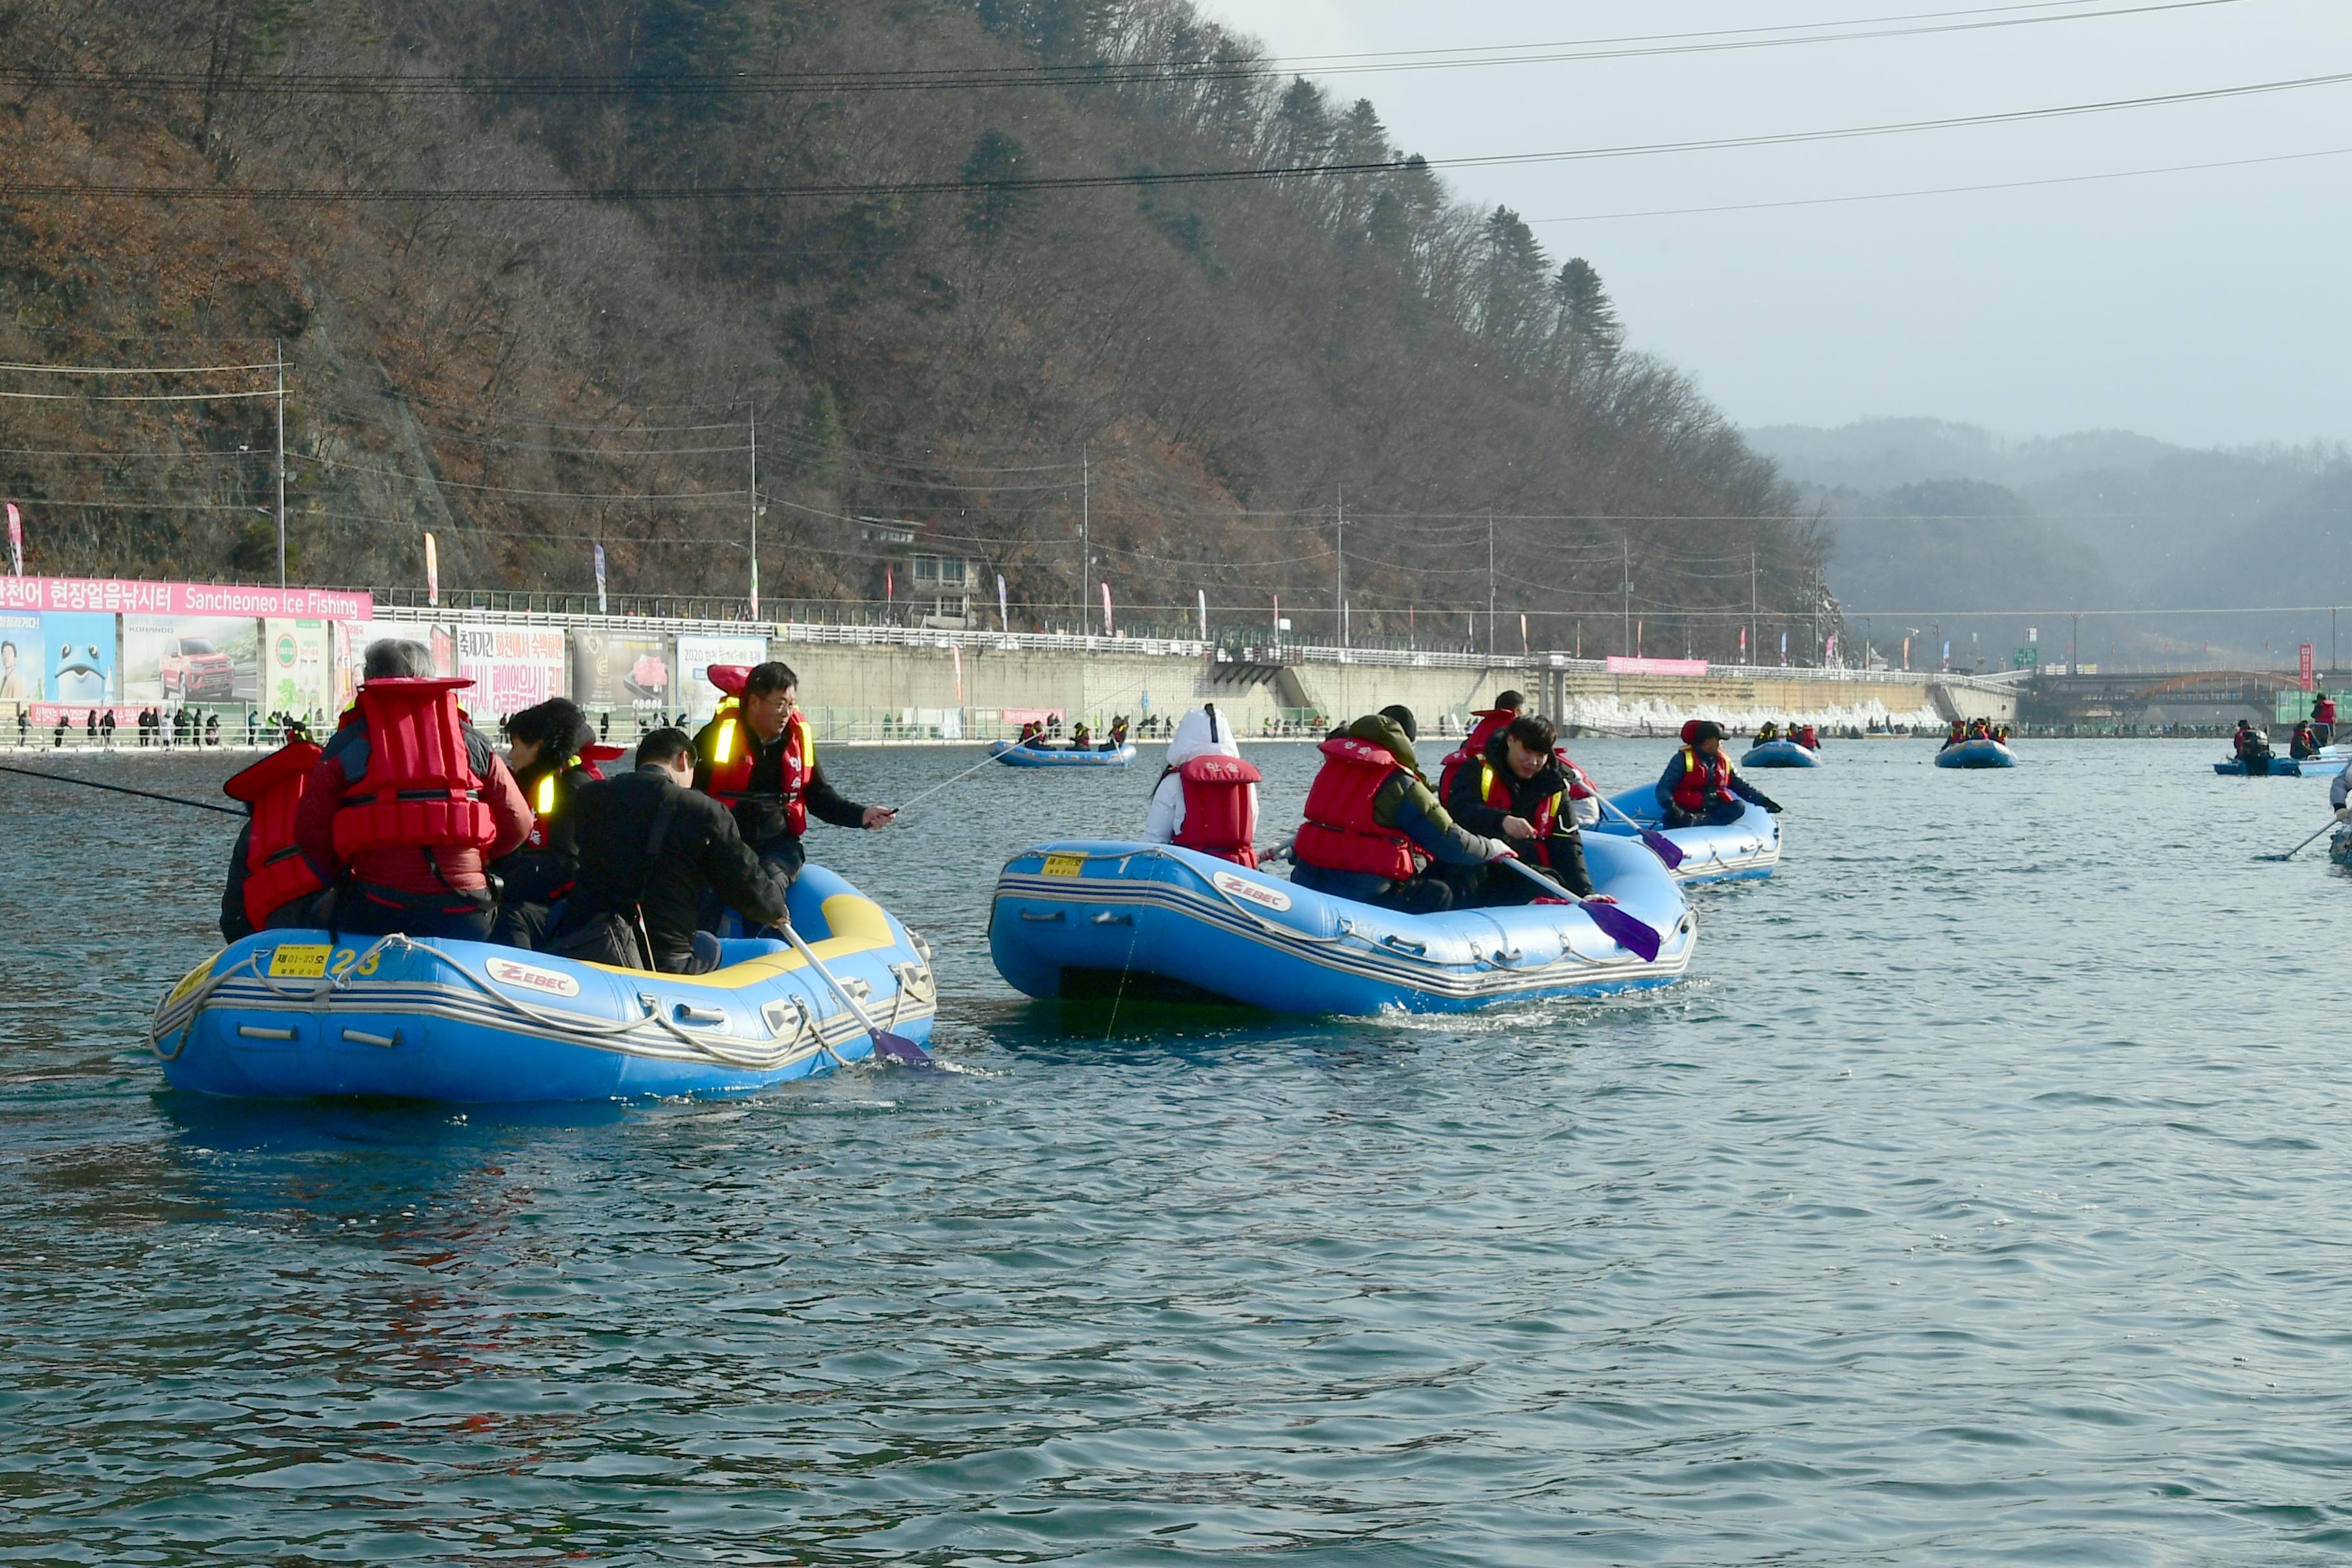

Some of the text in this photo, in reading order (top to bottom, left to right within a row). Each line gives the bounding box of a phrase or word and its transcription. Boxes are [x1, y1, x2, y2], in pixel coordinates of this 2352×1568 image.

[50, 580, 172, 611] 현장얼음낚시터
[186, 587, 277, 612] Sancheoneo
[283, 592, 304, 613] Ice
[308, 593, 358, 620] Fishing
[460, 630, 563, 660] 축제기간 화천에서 숙박하면
[684, 649, 703, 662] 2020
[1222, 877, 1284, 906] ZEBEC
[331, 948, 382, 976] 23
[497, 963, 569, 991] ZEBEC
